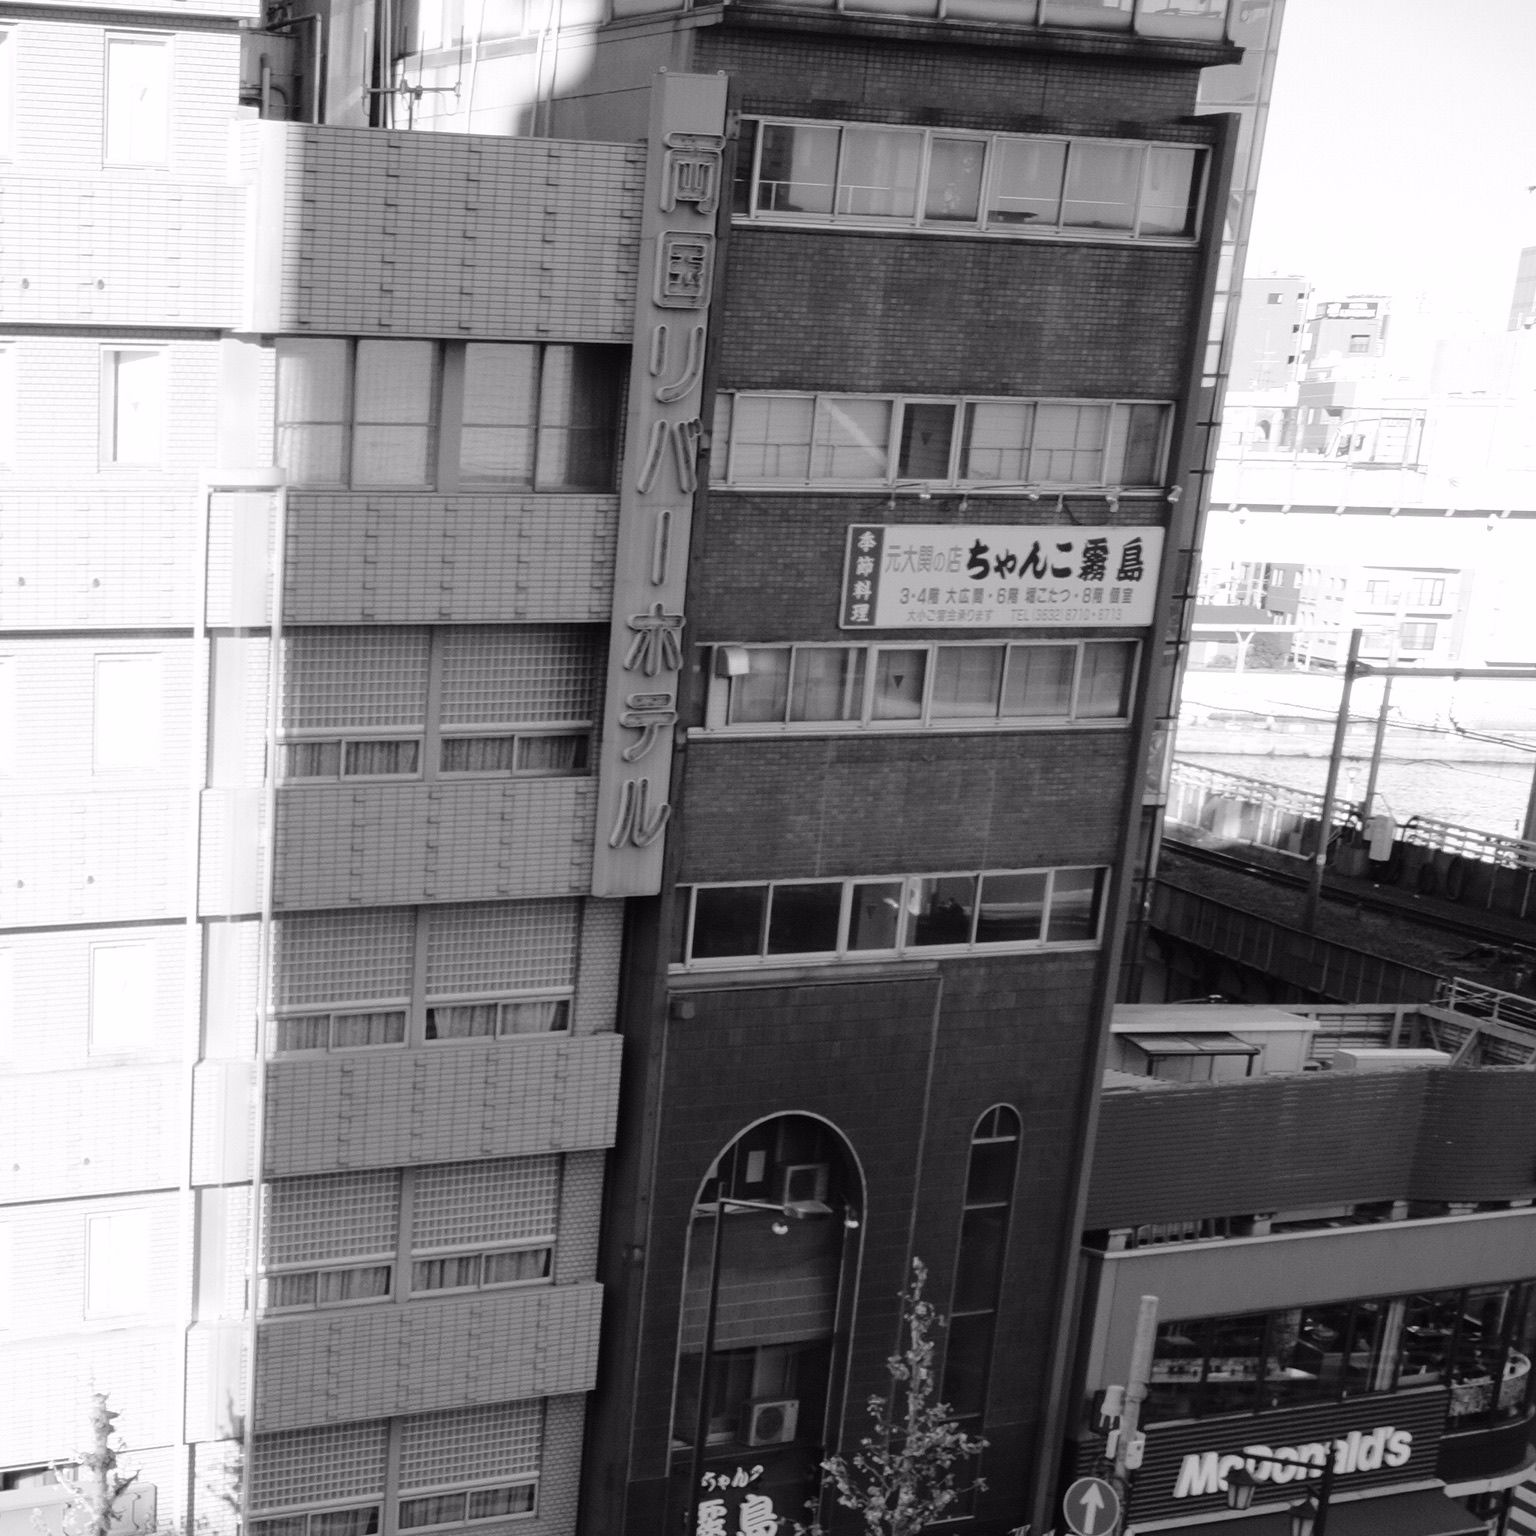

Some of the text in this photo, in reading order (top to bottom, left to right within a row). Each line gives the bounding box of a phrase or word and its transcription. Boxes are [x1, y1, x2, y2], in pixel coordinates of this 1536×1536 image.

[608, 131, 727, 850] 両国リバーホテル
[850, 531, 878, 624] 季節料理
[884, 536, 1145, 583] 元大関の店 ちゃんこ霧島
[1172, 1425, 1413, 1499] McDonald's
